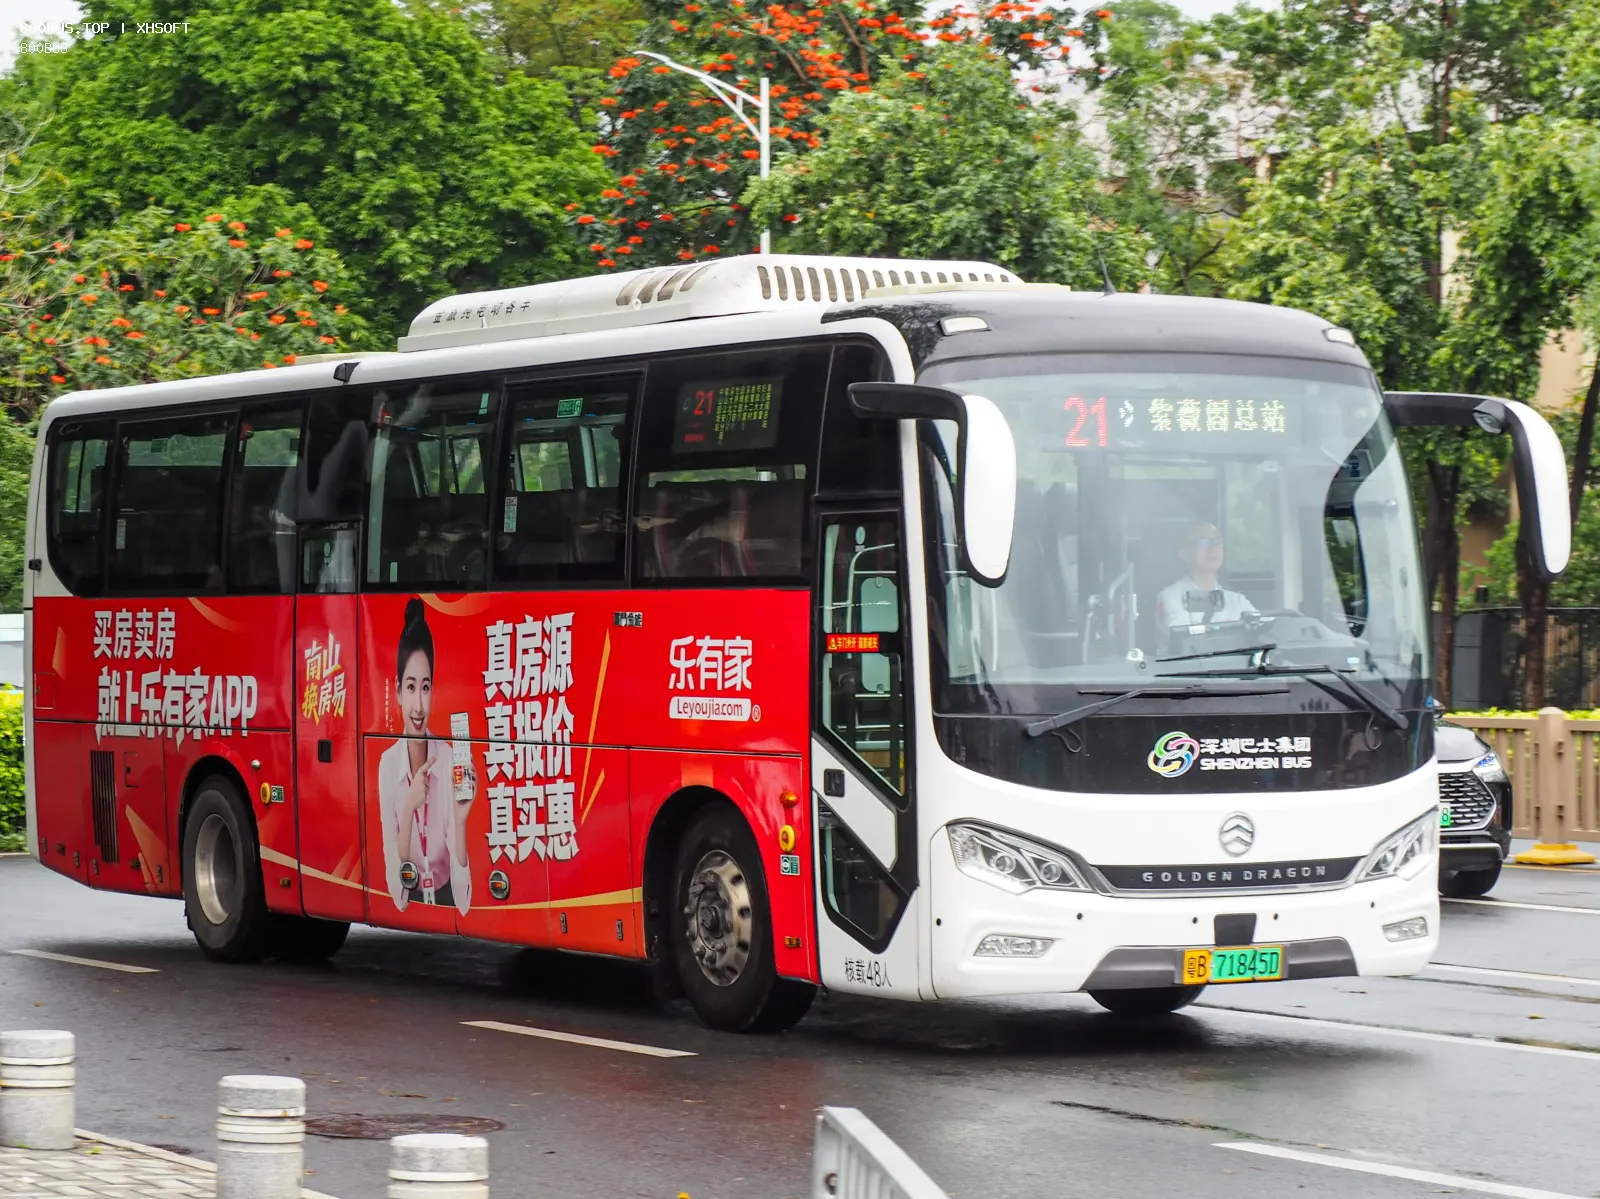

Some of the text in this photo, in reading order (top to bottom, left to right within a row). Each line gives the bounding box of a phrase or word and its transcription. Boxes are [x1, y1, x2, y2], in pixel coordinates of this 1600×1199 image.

[693, 390, 715, 415] 21
[1064, 396, 1109, 446] 21
[93, 607, 176, 660] 买房卖房
[304, 629, 341, 682] 南山
[481, 611, 575, 701] 真房源
[668, 634, 753, 691] 乐有家
[95, 664, 258, 752] 就上乐有家APP
[302, 672, 347, 727] 换房易
[676, 698, 744, 718] Leyoujia.com
[482, 696, 575, 782] 真报价
[1200, 737, 1312, 754] 深圳巴士集团
[1200, 756, 1313, 770] SHENZHEN BUS
[485, 777, 580, 864] 真实惠
[1142, 866, 1326, 882] GOLDEN DRAGON
